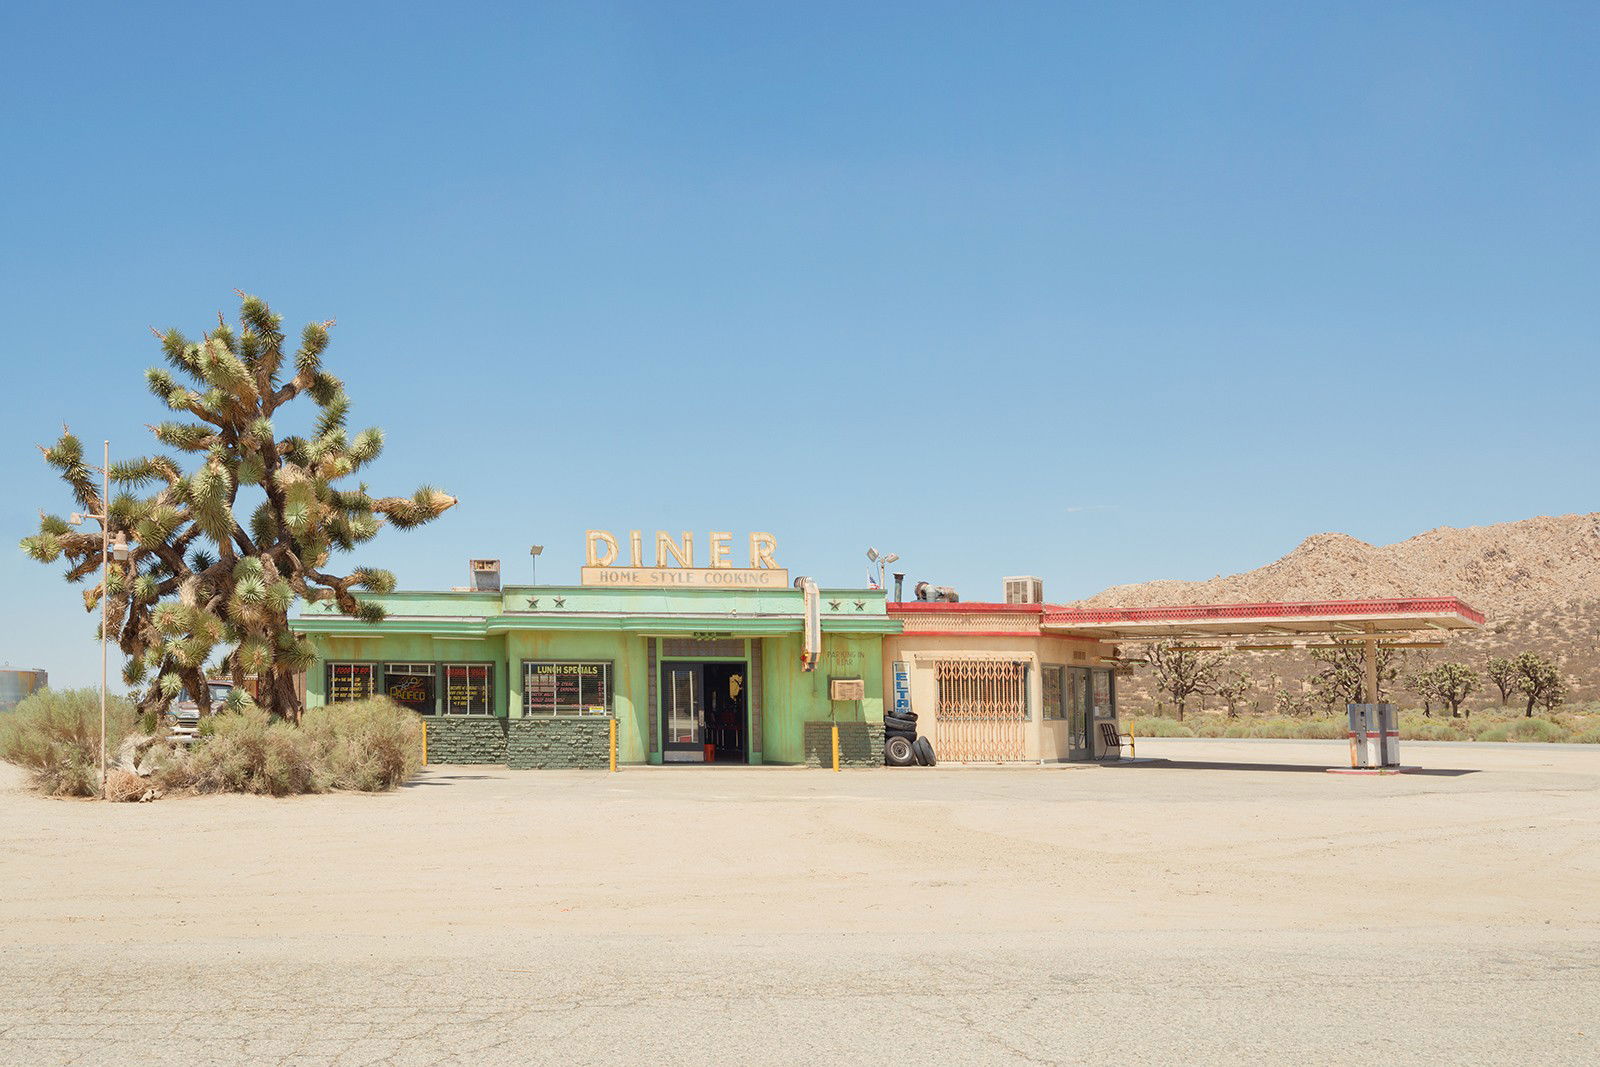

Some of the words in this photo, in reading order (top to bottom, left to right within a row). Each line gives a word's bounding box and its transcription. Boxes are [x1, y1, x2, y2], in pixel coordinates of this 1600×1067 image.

[586, 529, 781, 569] DINER
[600, 570, 640, 583] HOME
[650, 571, 694, 584] STYLE
[704, 572, 770, 584] COOKING
[537, 666, 562, 674] LUNCH
[563, 666, 598, 674] SPECIALS
[895, 663, 909, 708] ELTA
